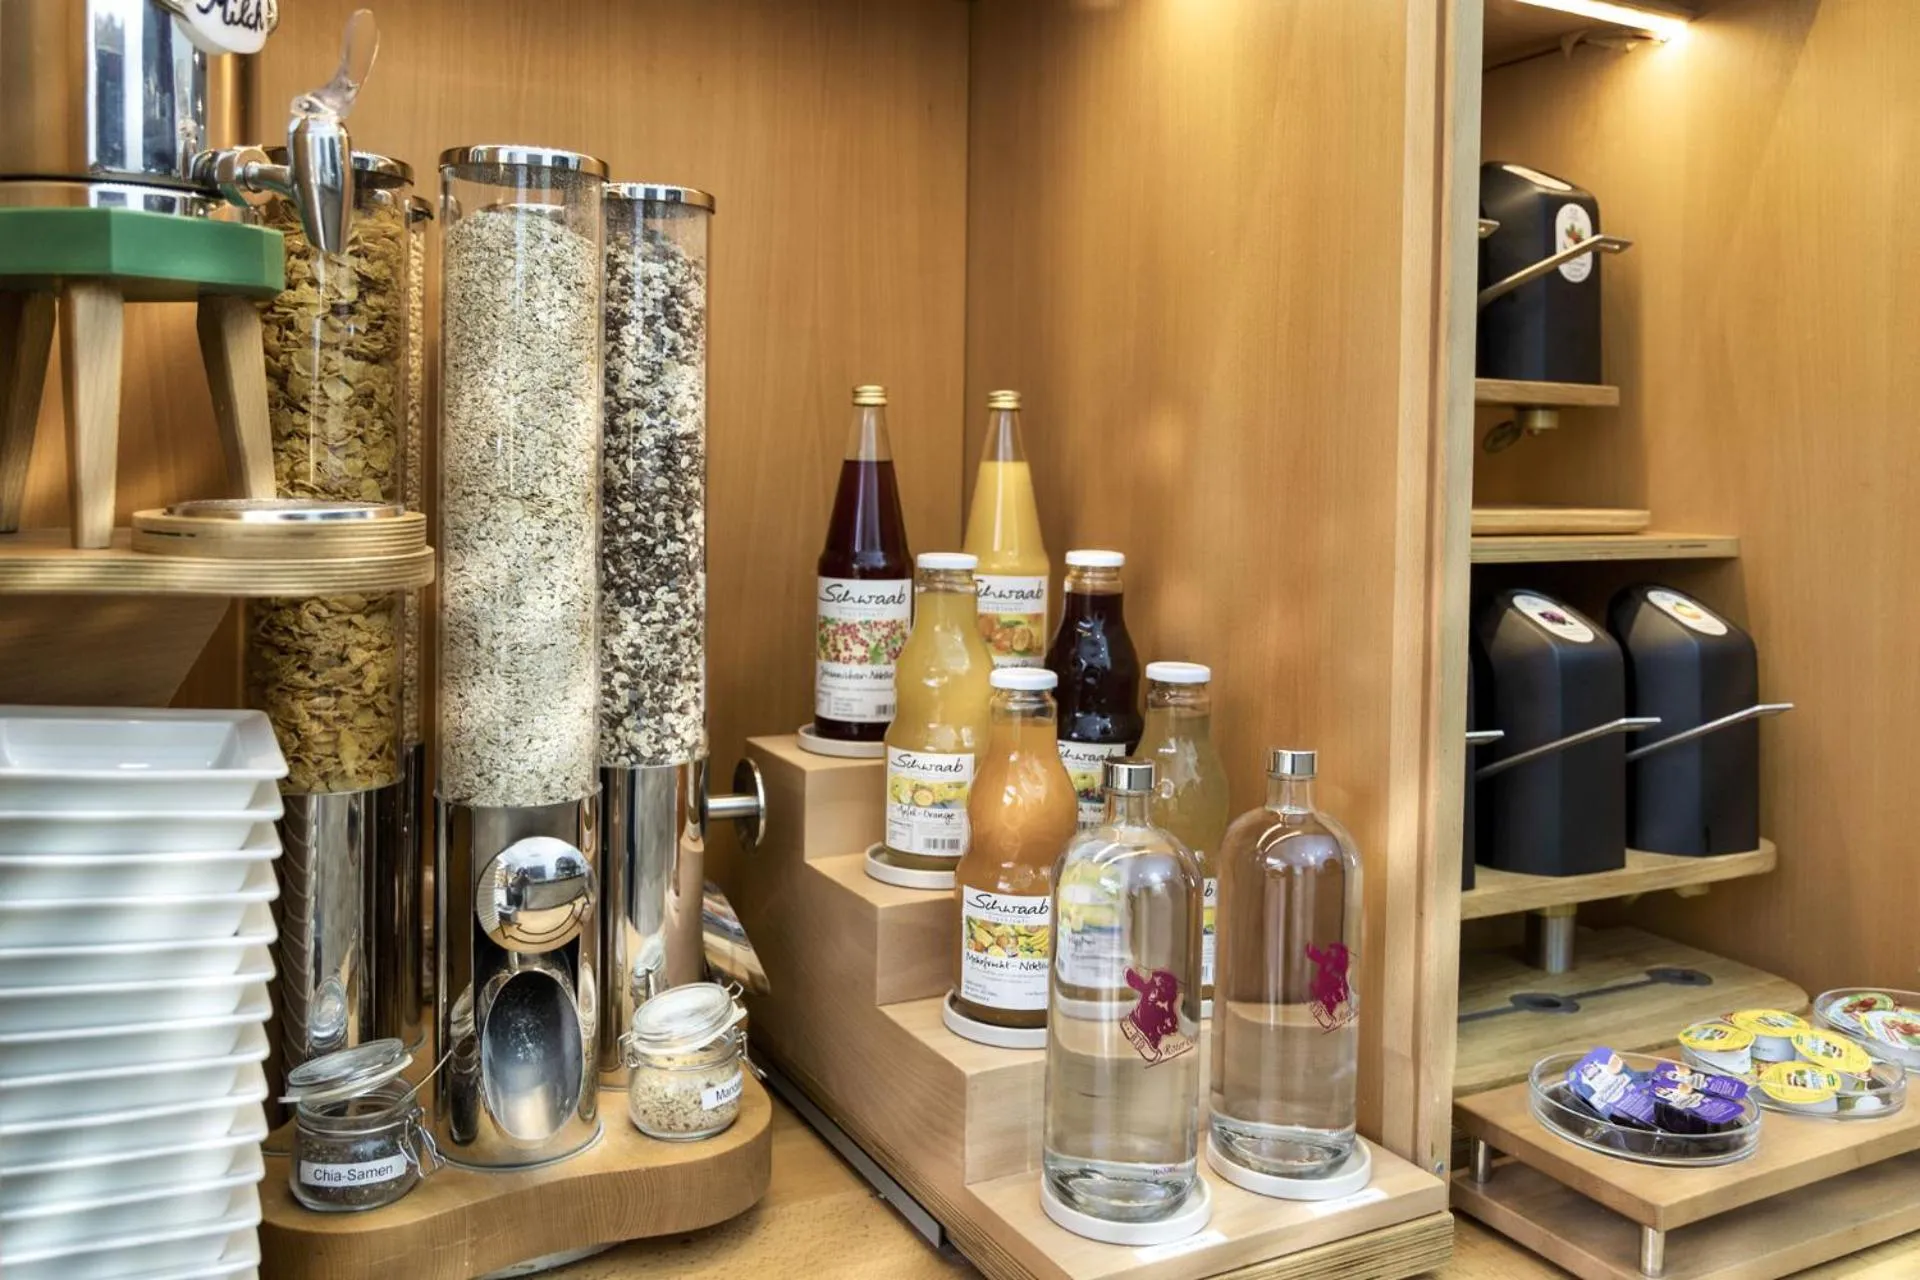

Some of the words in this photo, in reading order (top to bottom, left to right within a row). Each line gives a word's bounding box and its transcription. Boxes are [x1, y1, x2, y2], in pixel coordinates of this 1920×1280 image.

[819, 583, 907, 605] Schwaab
[891, 753, 964, 773] Schwaab
[966, 894, 1049, 915] Schwaab
[313, 1164, 394, 1182] Chia-Samen
